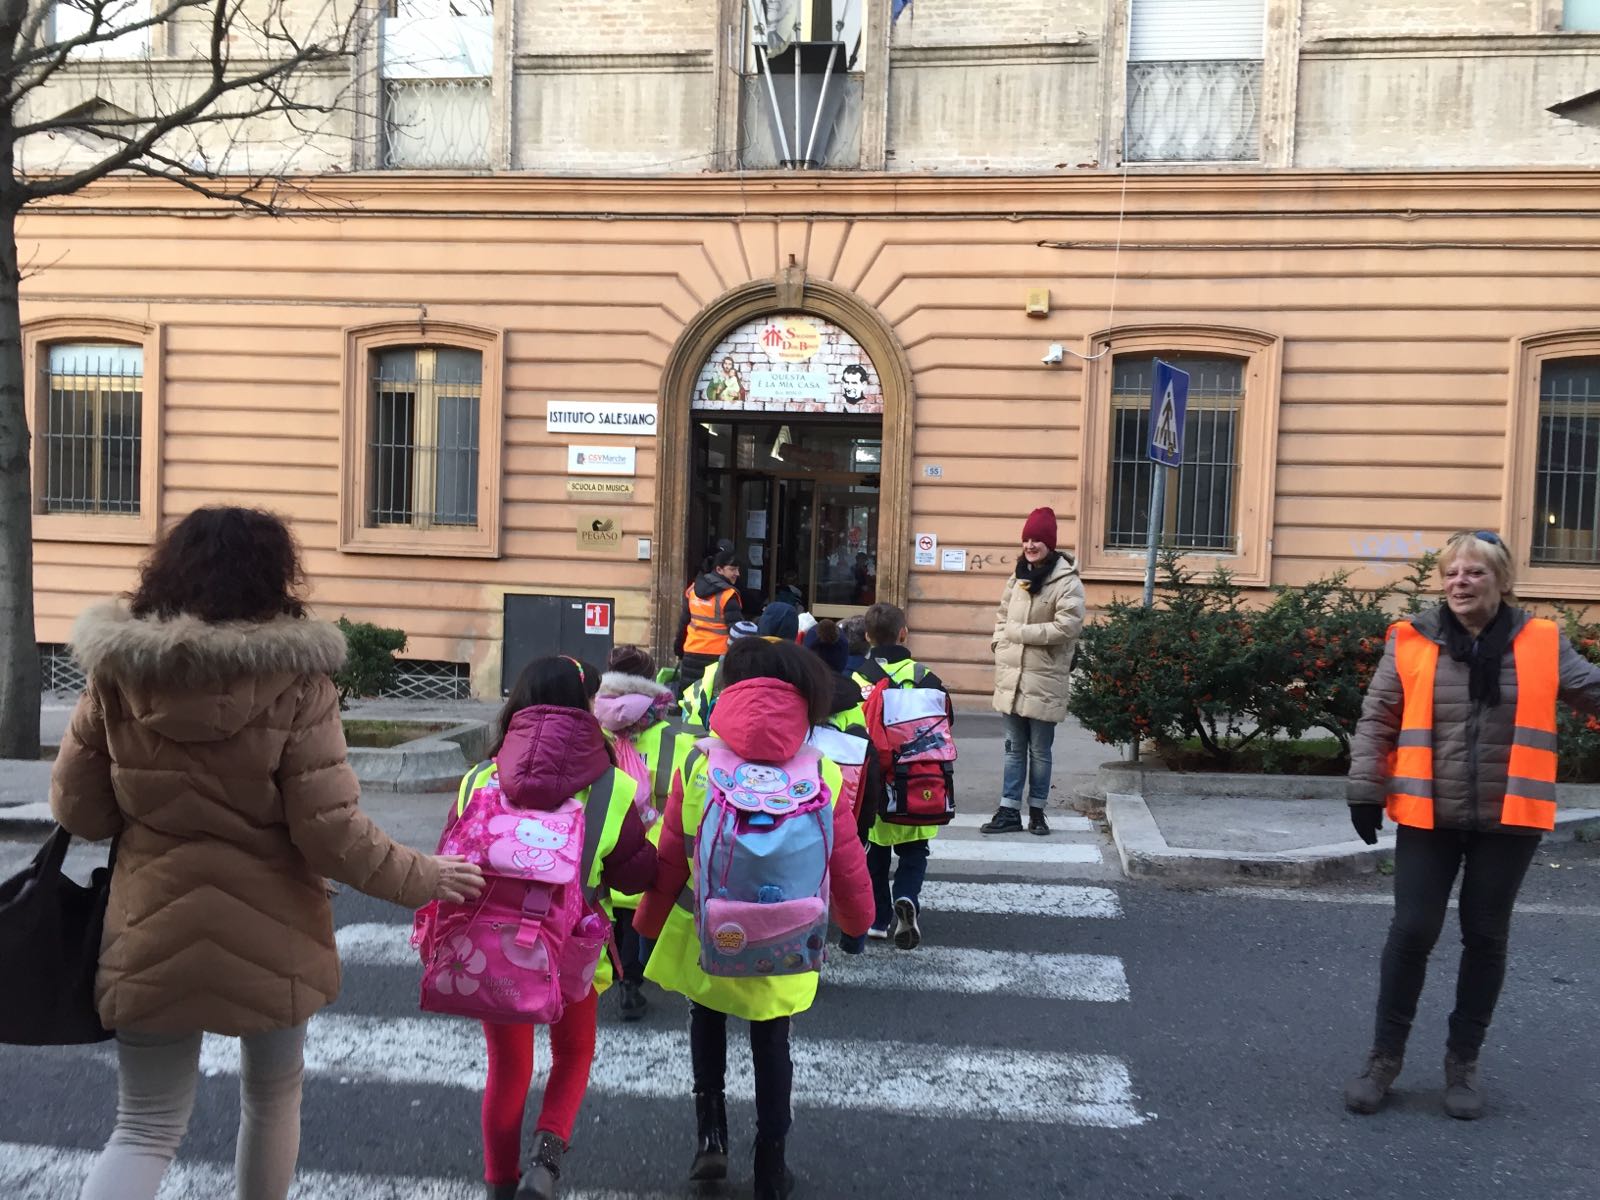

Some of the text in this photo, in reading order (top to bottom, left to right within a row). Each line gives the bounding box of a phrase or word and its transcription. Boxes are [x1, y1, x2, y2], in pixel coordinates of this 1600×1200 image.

[771, 373, 806, 381] QUESTA
[779, 381, 794, 389] MIA
[550, 411, 656, 426] ISTITUTO SALESIANO
[929, 467, 939, 475] 55
[571, 482, 630, 492] SCUOLA DI MUSICA
[581, 531, 618, 540] PEGASO
